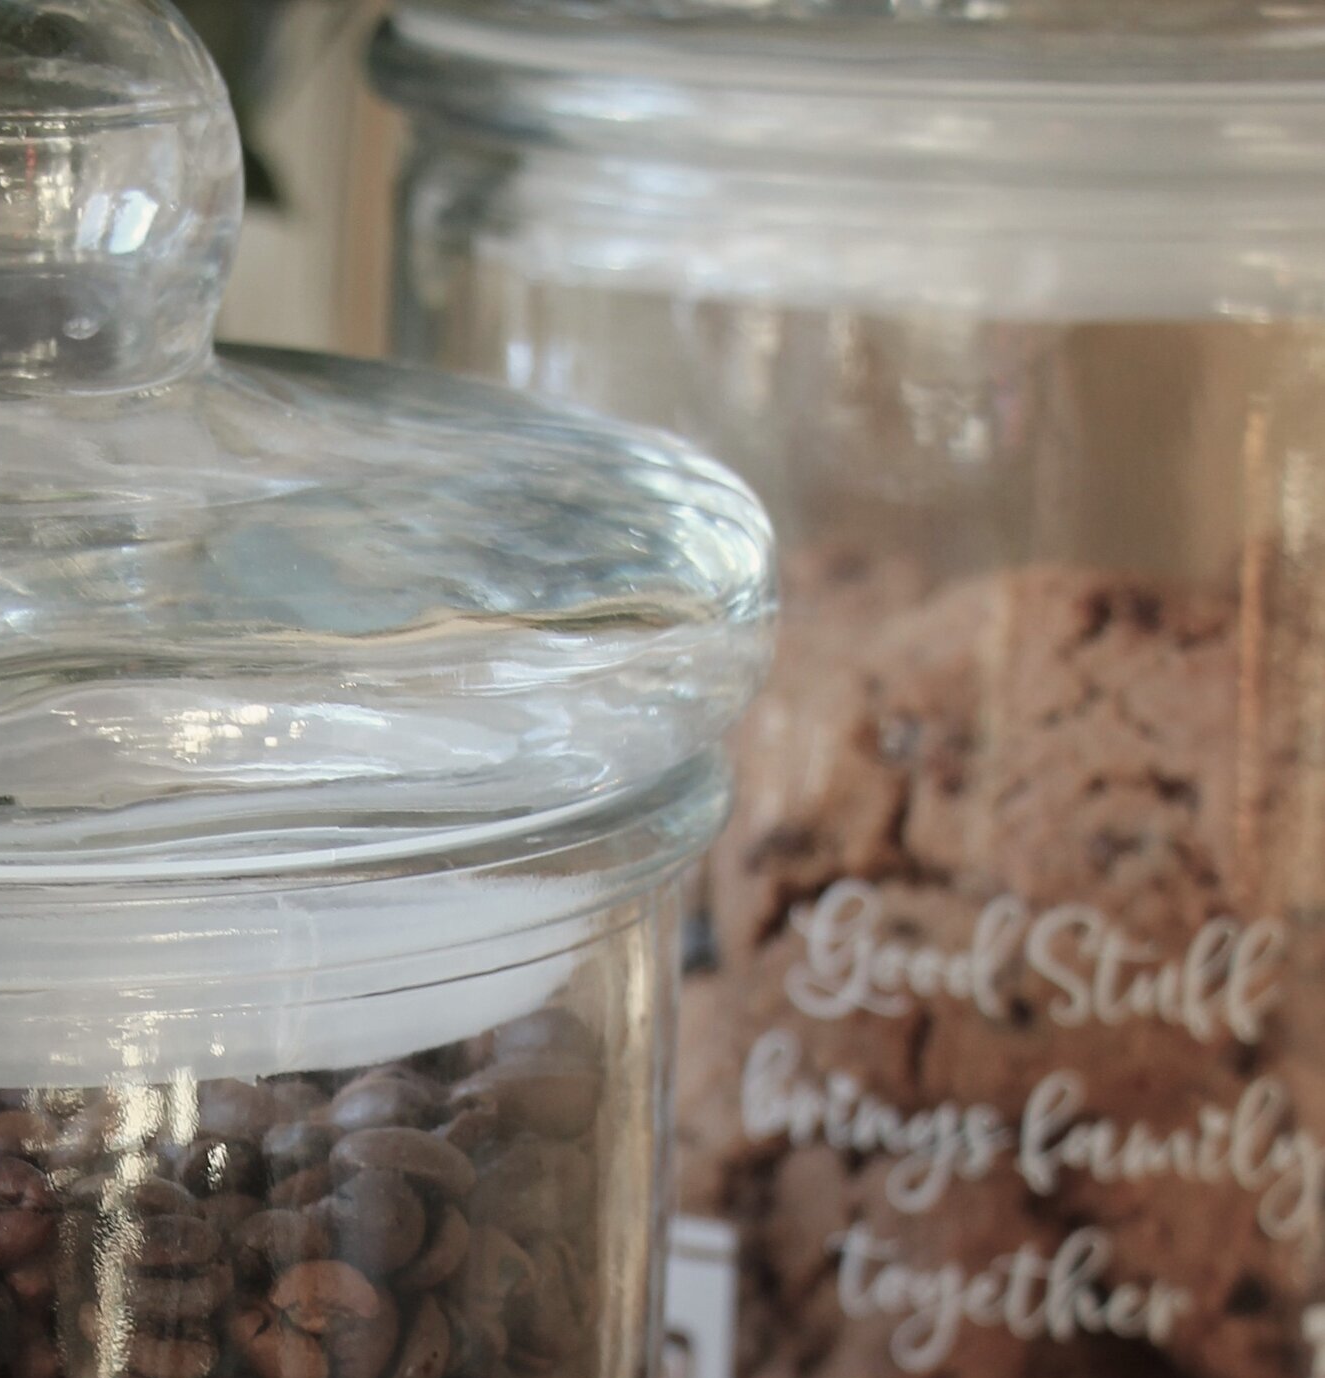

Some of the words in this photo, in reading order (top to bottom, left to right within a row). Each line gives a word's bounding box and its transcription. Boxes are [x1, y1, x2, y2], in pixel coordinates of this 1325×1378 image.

[785, 879, 1025, 1018] Good
[1025, 903, 1285, 1043] Stuff
[742, 1028, 1012, 1213] brings
[1017, 1070, 1325, 1240] family
[827, 1222, 1190, 1373] together
